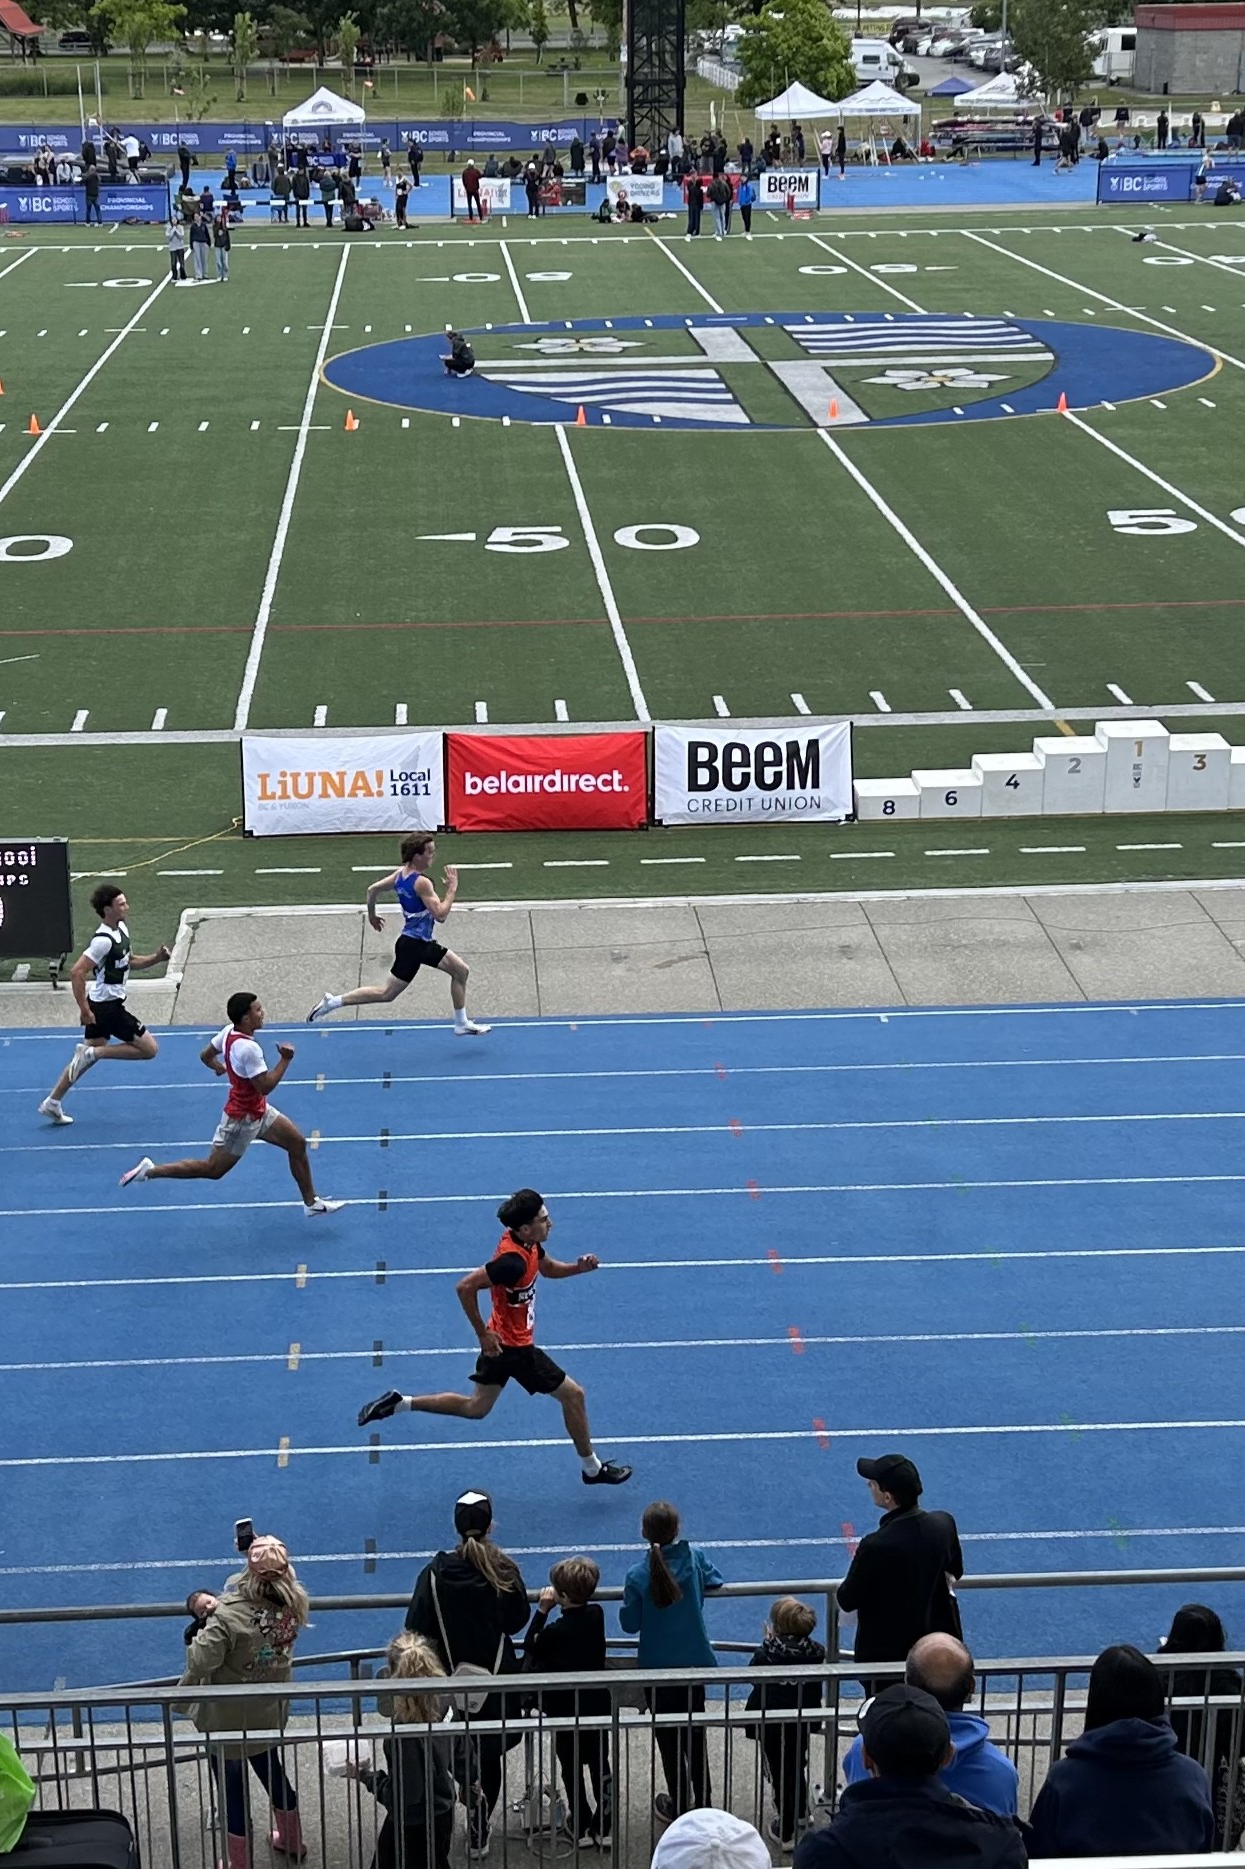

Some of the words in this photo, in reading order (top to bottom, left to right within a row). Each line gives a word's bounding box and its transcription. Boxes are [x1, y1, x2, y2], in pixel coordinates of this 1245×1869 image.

[30, 134, 46, 147] BC
[162, 133, 178, 145] BC
[288, 132, 298, 145] C
[411, 130, 427, 143] BC
[541, 129, 557, 141] BC
[1123, 177, 1142, 191] BC
[31, 197, 51, 212] BC
[1134, 740, 1144, 757] 1
[1067, 757, 1082, 774] 2
[1192, 753, 1207, 771] 3
[257, 769, 385, 801] LiUNA!
[390, 768, 432, 782] Local
[1005, 773, 1021, 790] 4
[390, 782, 432, 797] 1611
[687, 797, 753, 813] CREDIT
[761, 795, 822, 811] UNION
[944, 790, 959, 806] 6
[882, 799, 896, 816] 8
